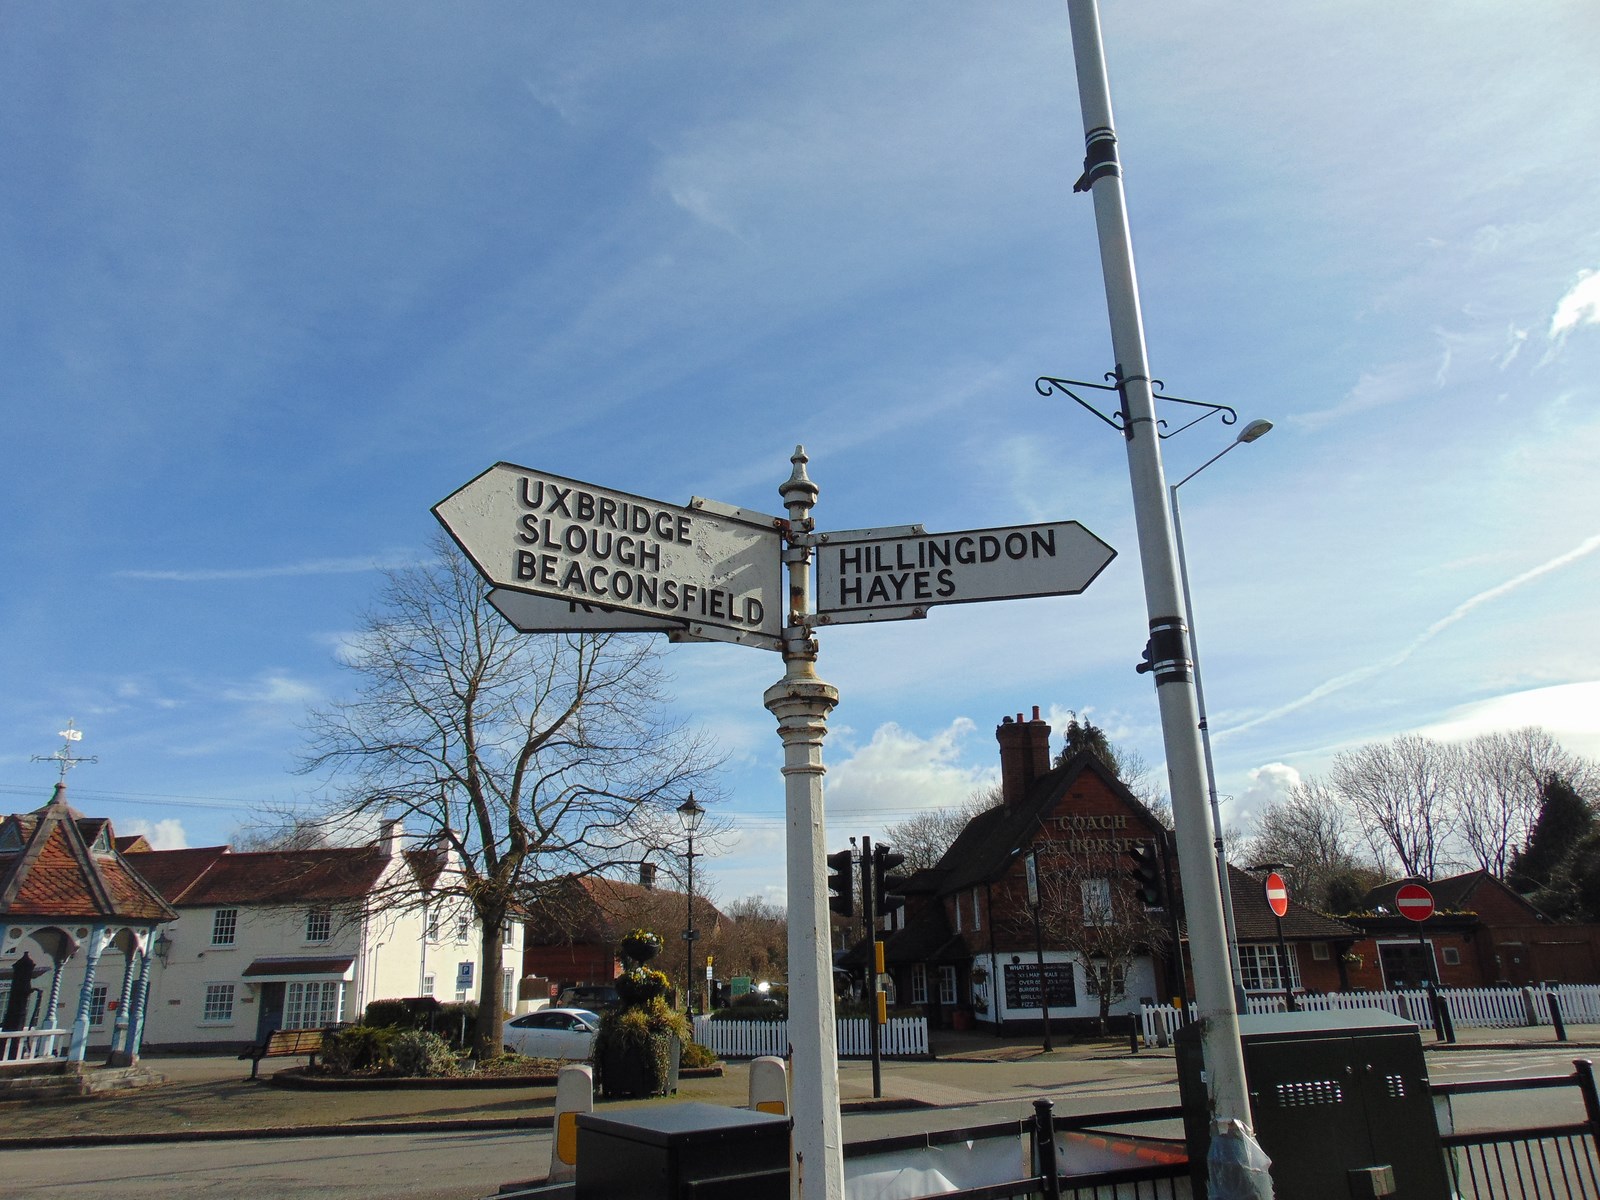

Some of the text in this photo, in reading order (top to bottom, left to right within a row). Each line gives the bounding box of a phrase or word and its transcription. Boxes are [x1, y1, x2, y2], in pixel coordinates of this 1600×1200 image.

[522, 477, 692, 546] UXBRIDGE
[519, 514, 660, 572] SLOUGH
[840, 529, 1056, 575] HILLINGDON
[517, 549, 764, 625] BEACONSFIELD
[840, 568, 956, 605] HAYES
[1058, 815, 1128, 831] COACH
